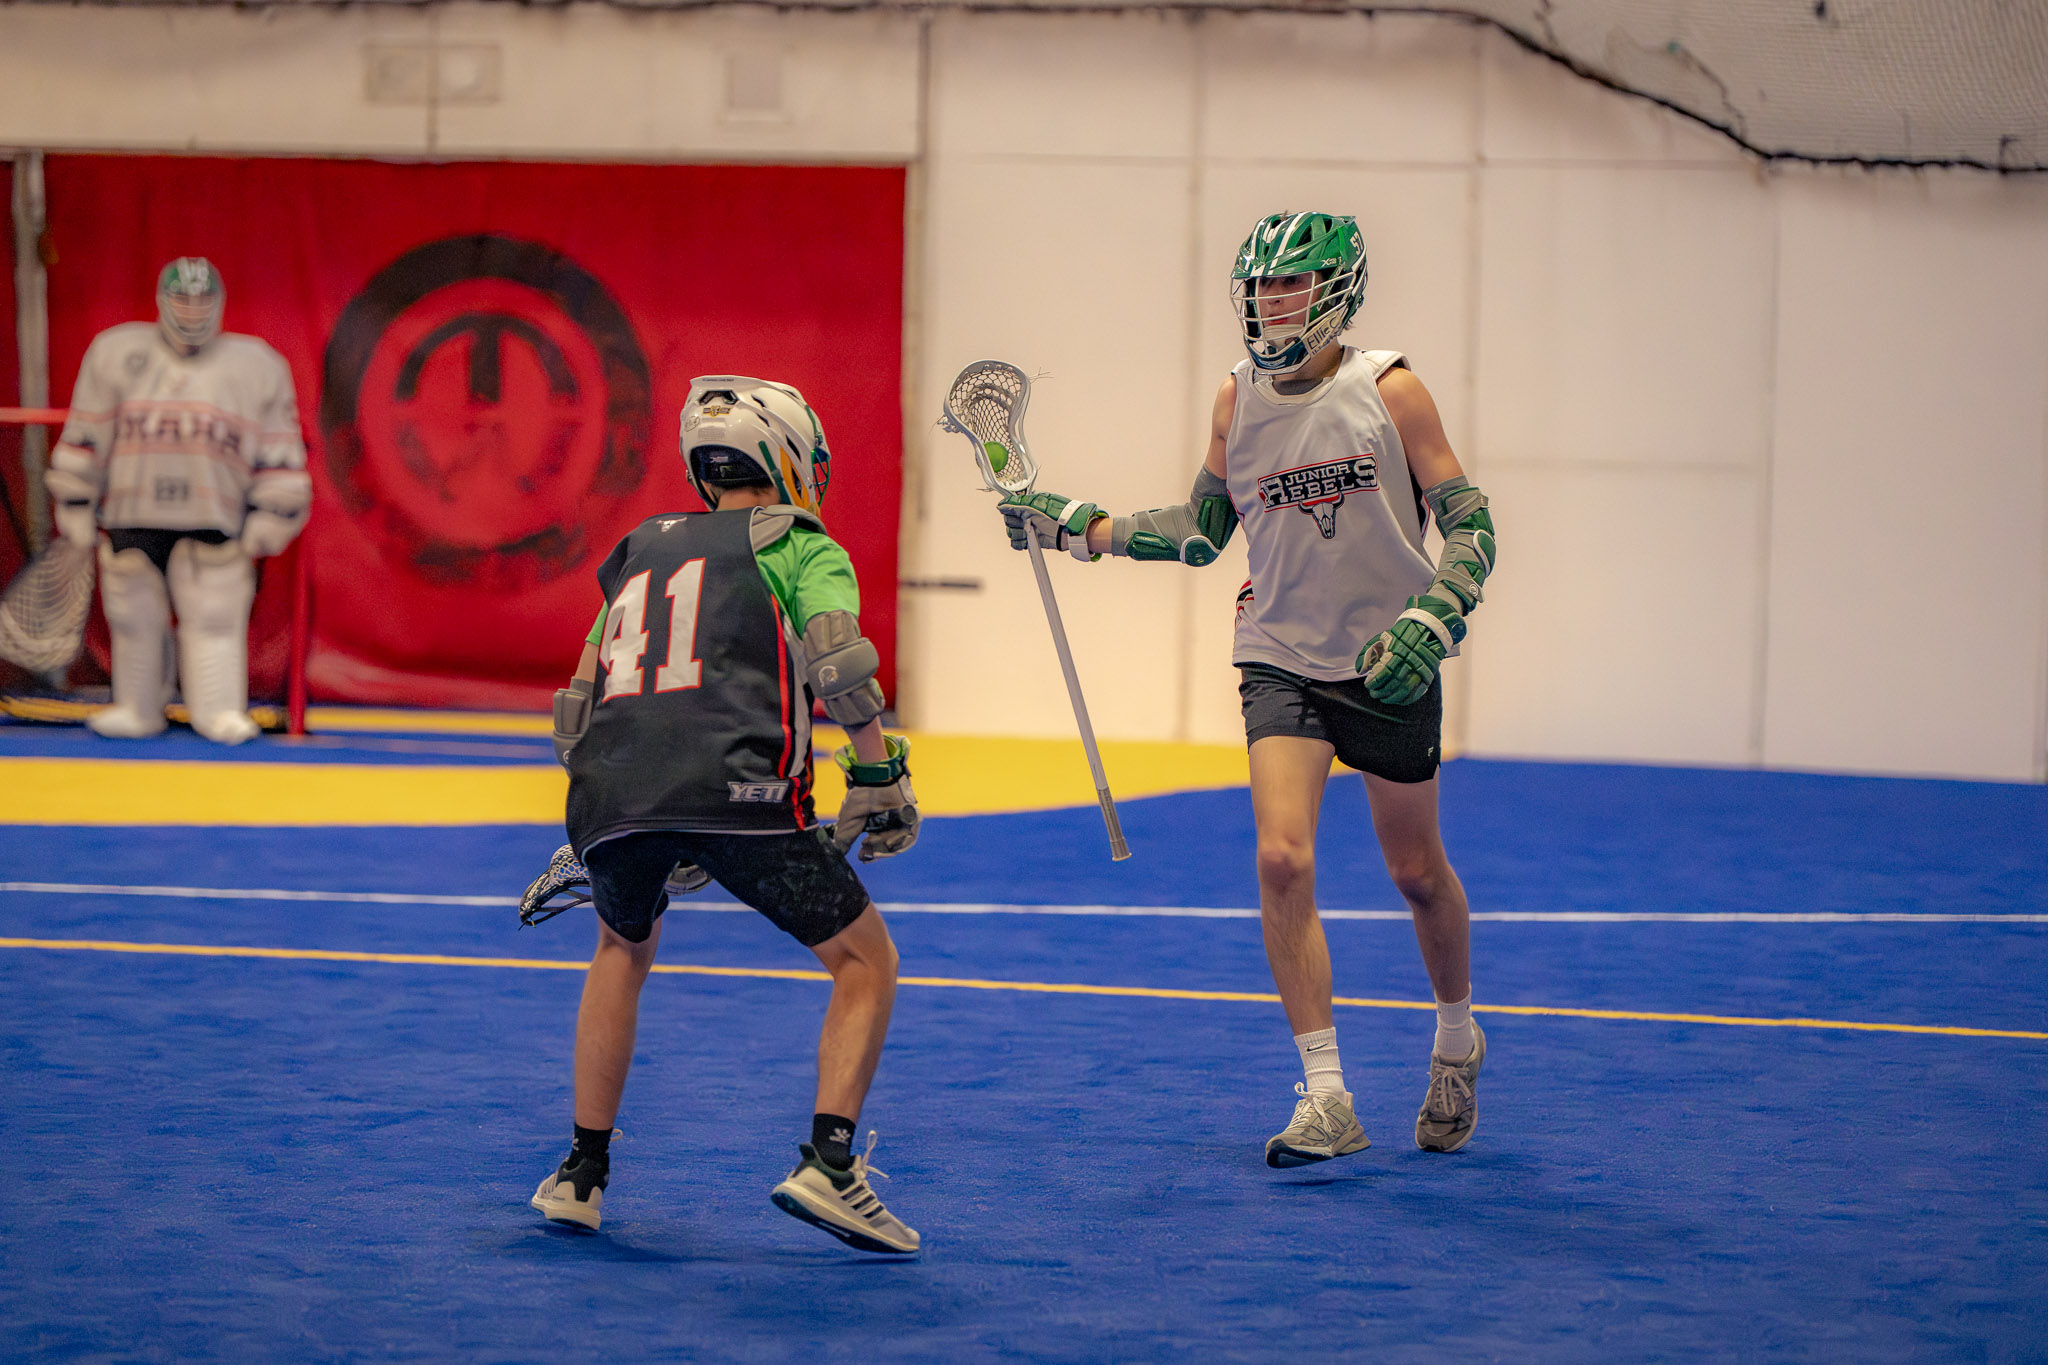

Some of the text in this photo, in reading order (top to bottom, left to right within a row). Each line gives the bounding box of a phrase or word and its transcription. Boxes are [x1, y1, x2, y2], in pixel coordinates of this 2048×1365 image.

[1259, 457, 1378, 508] REBELS
[1285, 463, 1352, 486] JUNIOR
[598, 556, 706, 703] 41
[726, 780, 790, 804] YETI
